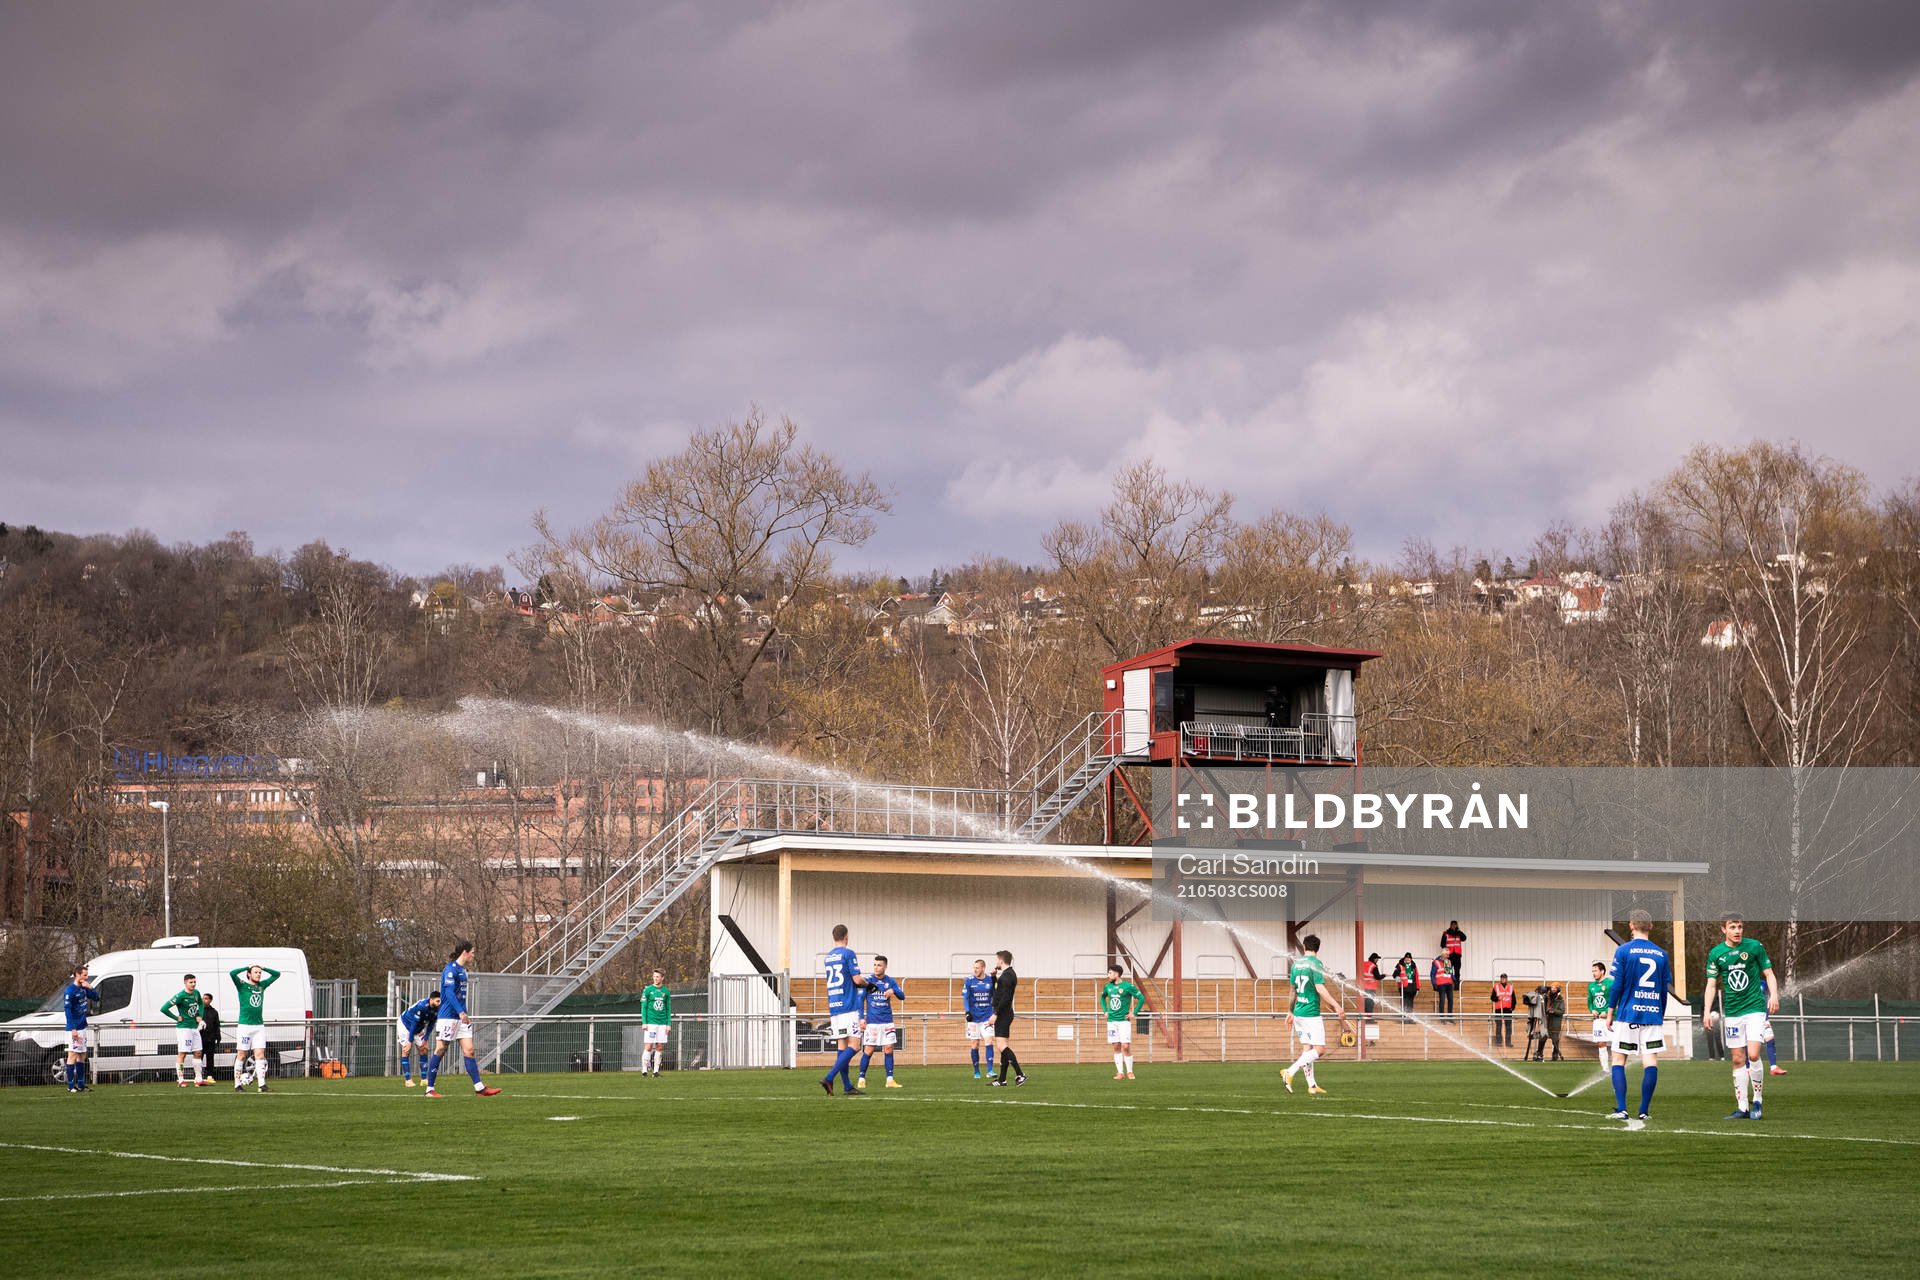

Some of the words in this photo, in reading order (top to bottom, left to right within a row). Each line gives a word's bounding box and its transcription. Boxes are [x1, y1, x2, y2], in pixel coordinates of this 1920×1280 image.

[142, 751, 278, 778] Husqvarn
[825, 964, 844, 989] 23
[1294, 975, 1309, 994] 17
[1638, 957, 1657, 988] 2
[1634, 990, 1660, 1000] BJÖRKÉN
